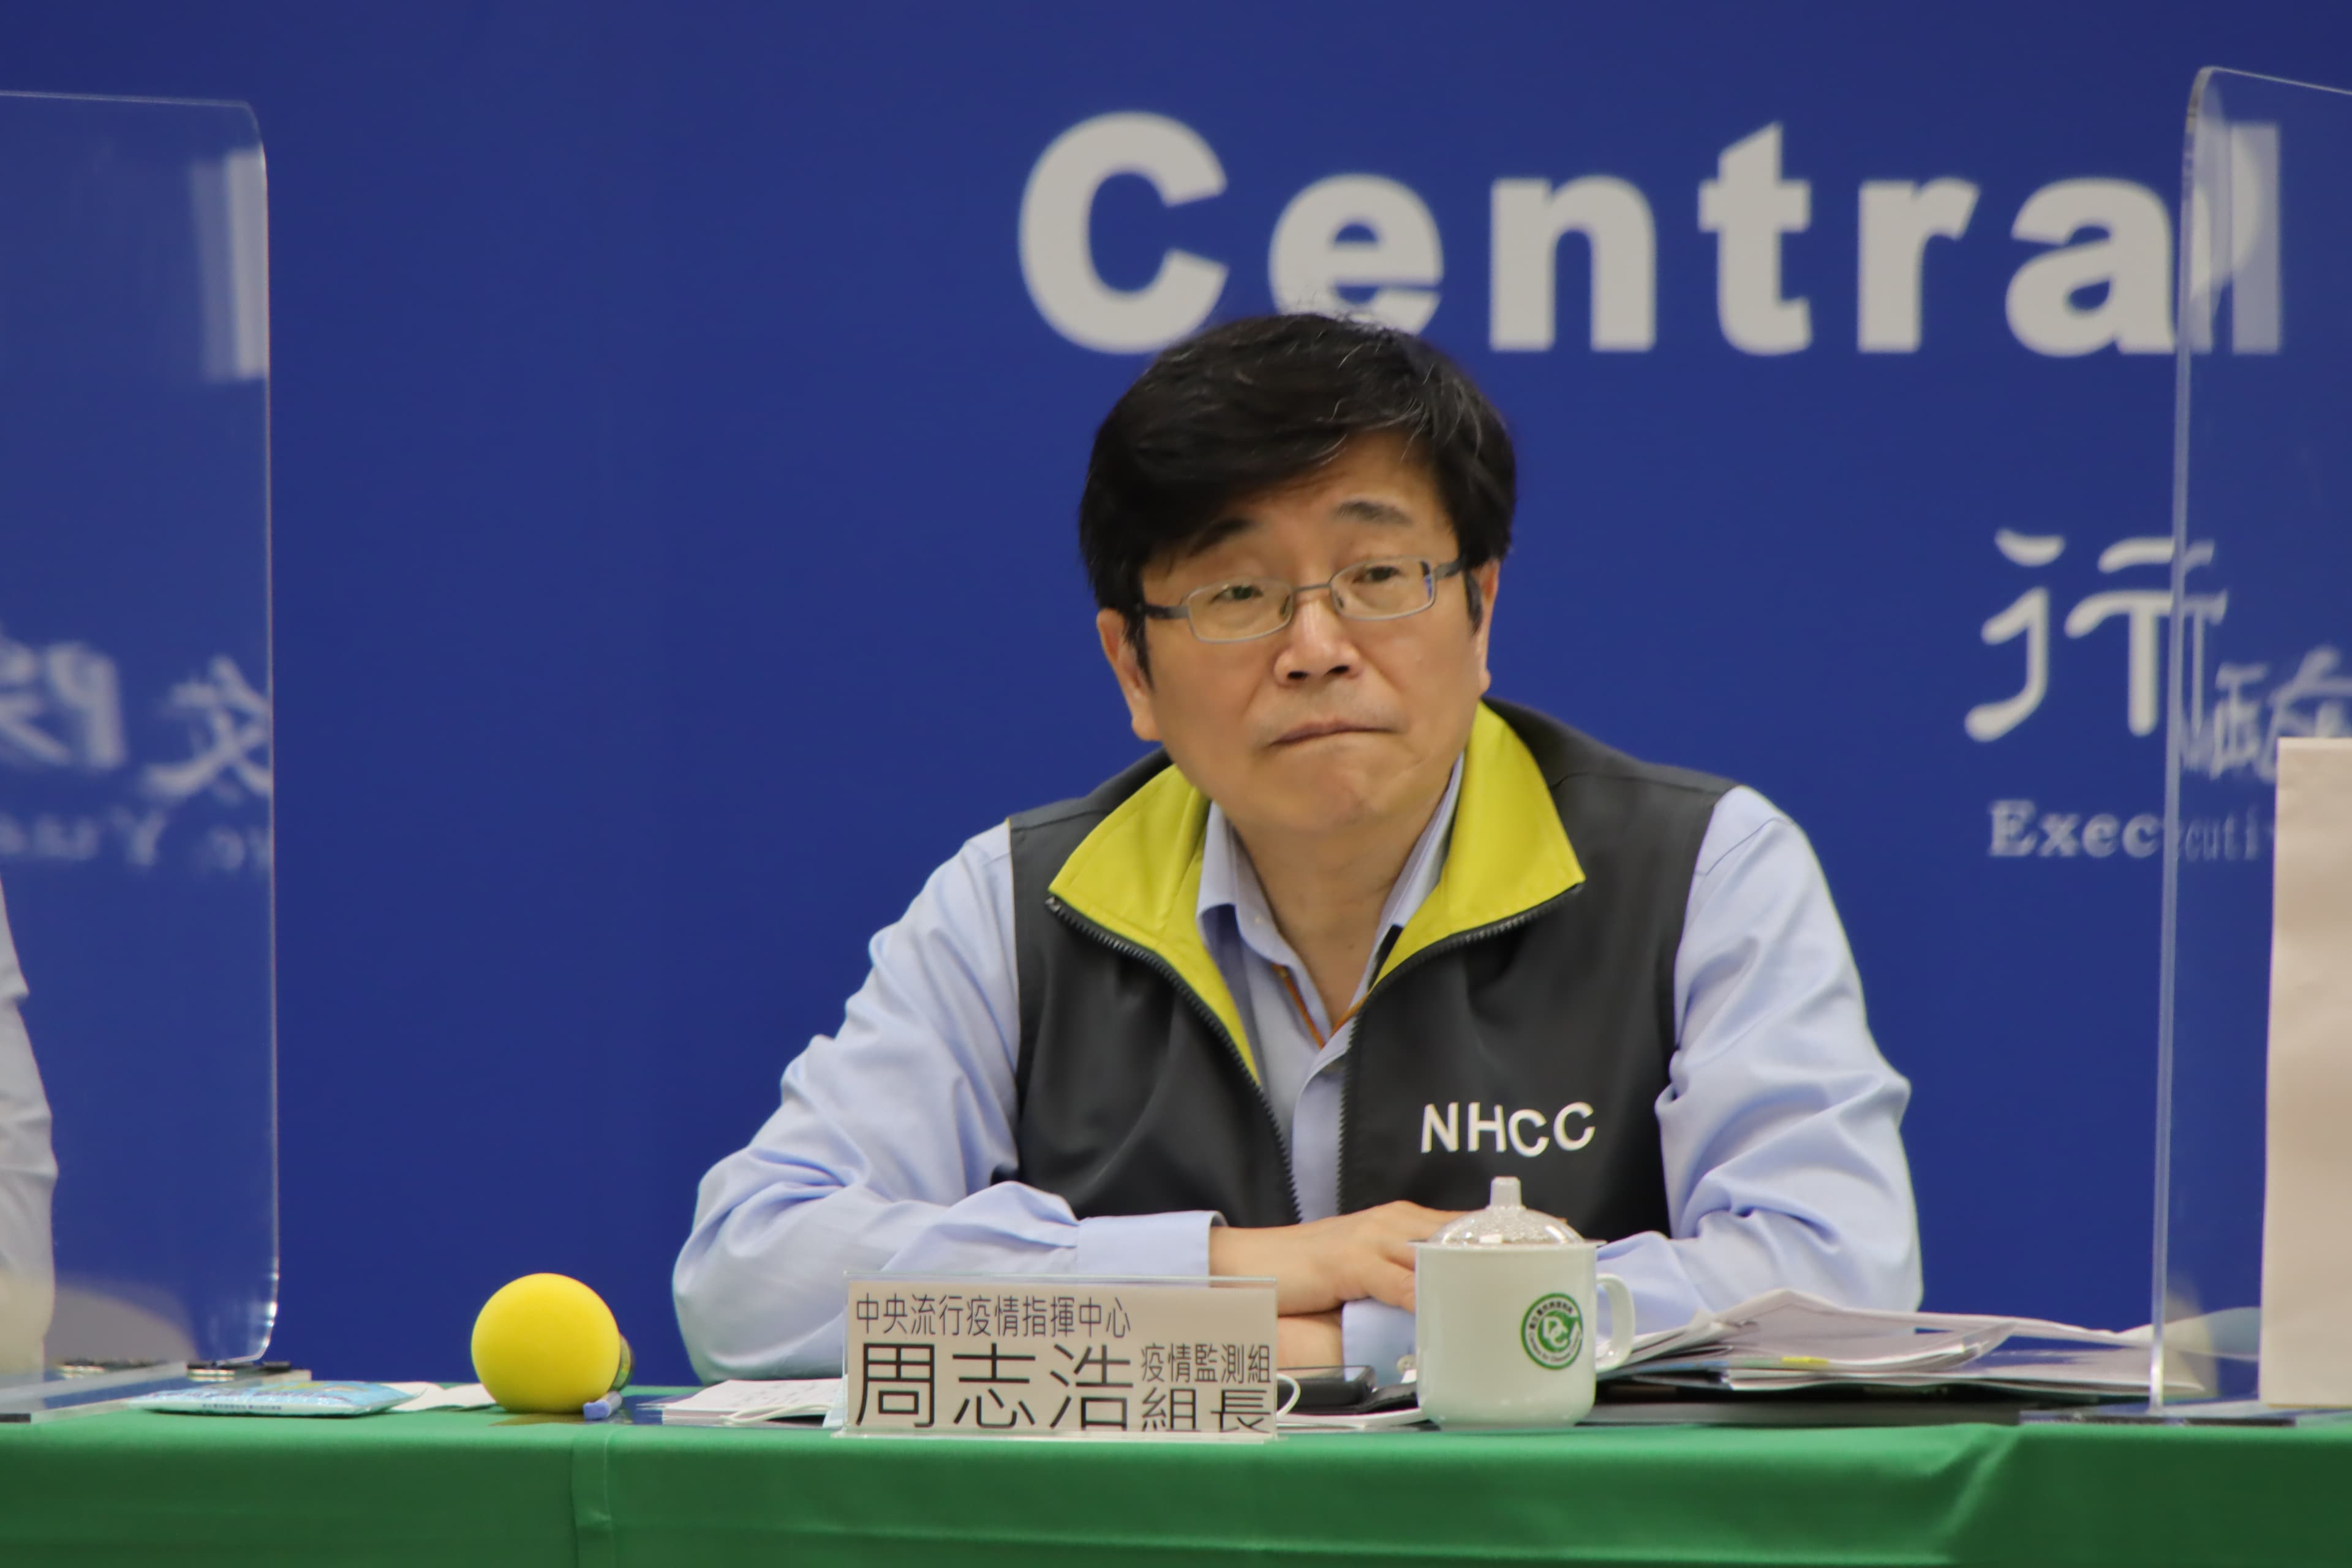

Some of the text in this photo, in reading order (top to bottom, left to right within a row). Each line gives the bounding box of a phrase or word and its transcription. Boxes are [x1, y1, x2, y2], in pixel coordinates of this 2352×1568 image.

[1018, 110, 2282, 358] Central
[1420, 1101, 1596, 1157] NHCC
[856, 1293, 1131, 1338] 中央流行疫情指揮中心
[856, 1342, 1134, 1431] 周志浩
[1140, 1343, 1272, 1384] 疫情監測組
[1141, 1387, 1272, 1434] 組長
